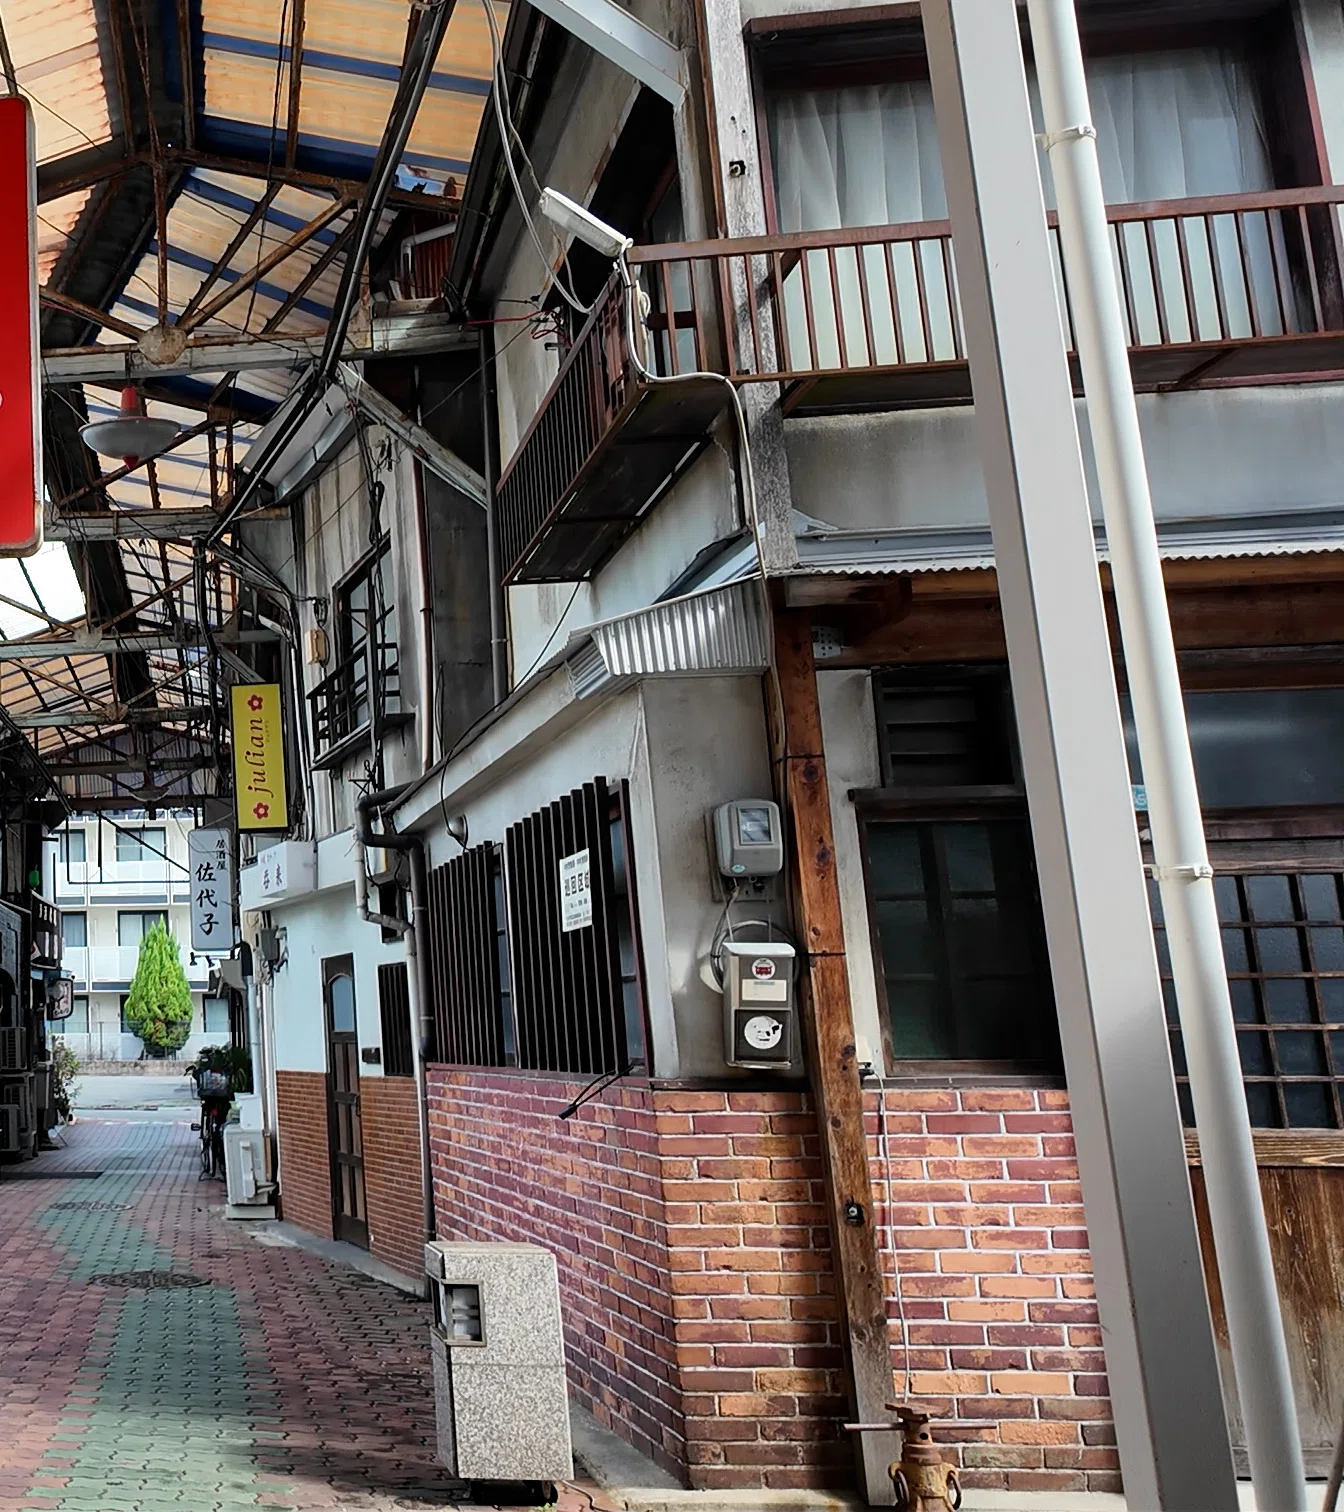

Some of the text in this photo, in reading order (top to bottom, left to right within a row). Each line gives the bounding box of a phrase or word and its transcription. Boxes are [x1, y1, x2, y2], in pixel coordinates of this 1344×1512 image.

[245, 717, 274, 798] julian
[216, 839, 227, 870] 居酒屋
[195, 861, 219, 936] 佐代子
